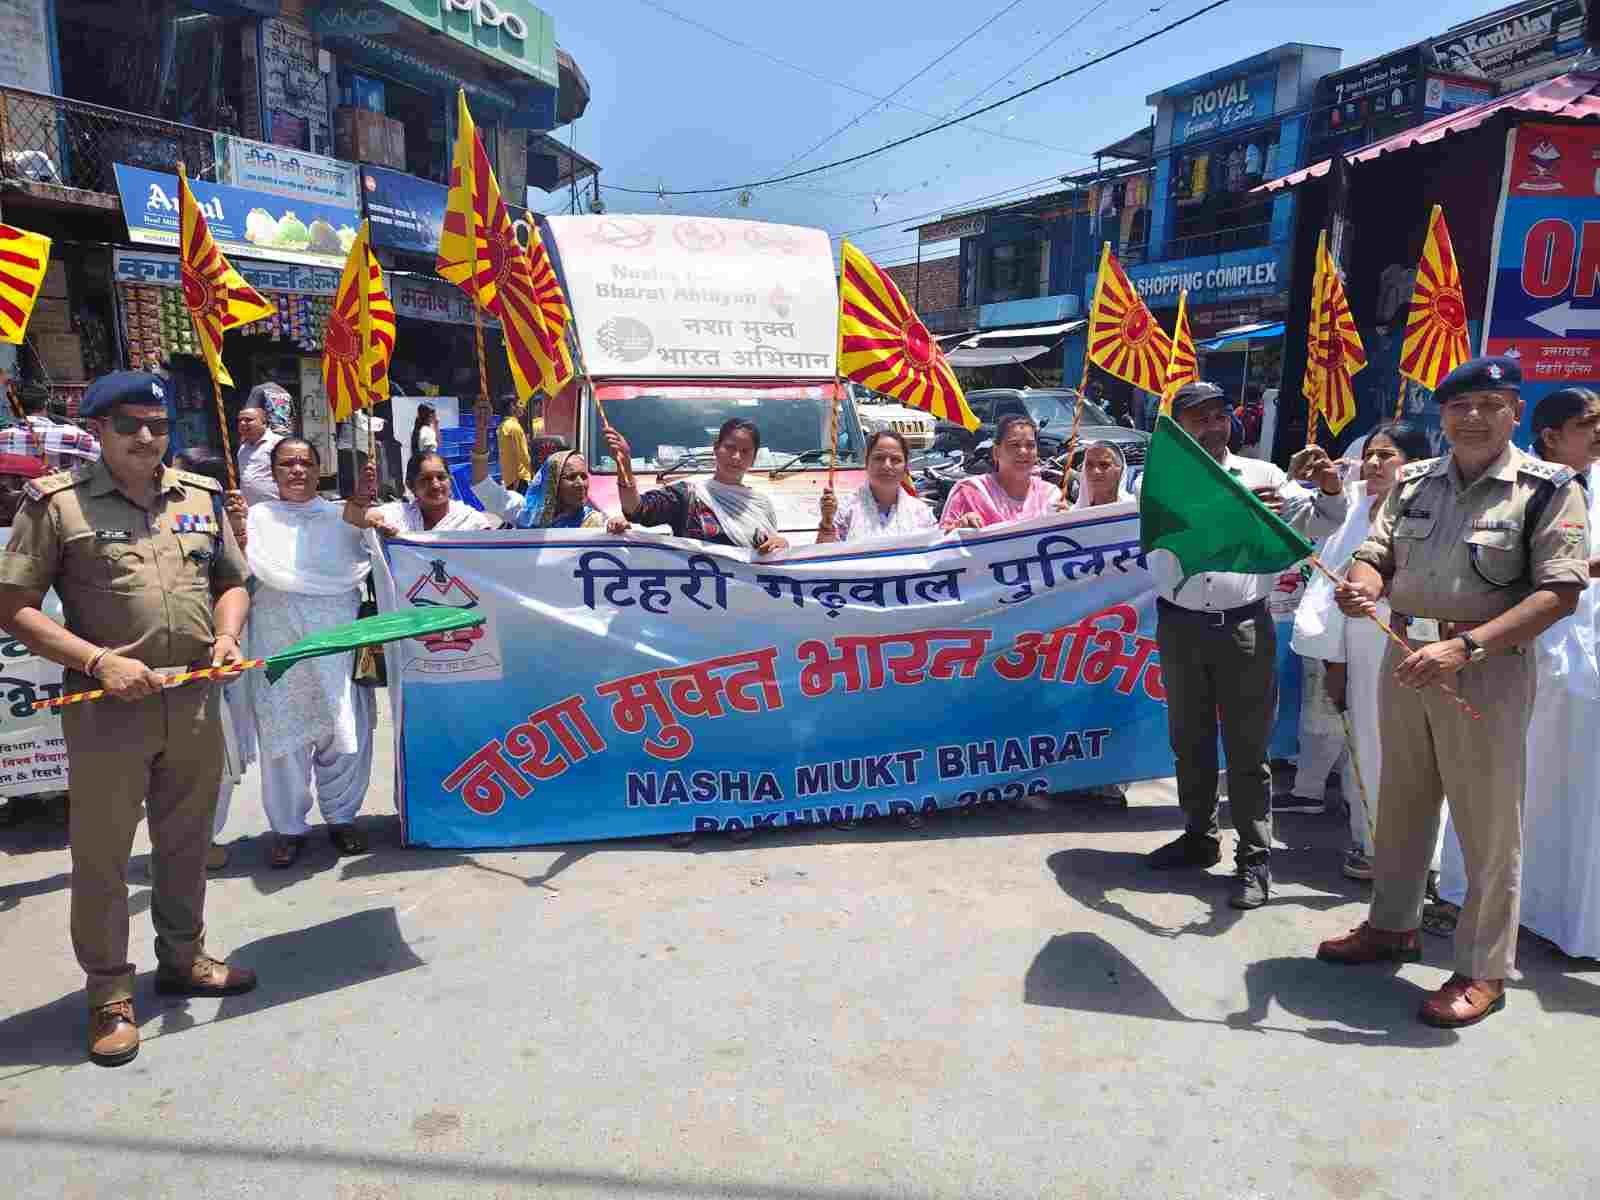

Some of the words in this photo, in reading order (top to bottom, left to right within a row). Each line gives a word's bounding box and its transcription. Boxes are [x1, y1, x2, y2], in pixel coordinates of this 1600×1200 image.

[1190, 80, 1249, 117] ROYAL
[146, 183, 225, 220] Aul
[1136, 269, 1203, 297] SHOPPING
[1206, 262, 1277, 289] COMPLEX
[681, 317, 733, 337] नशा
[741, 320, 796, 344] मुक्त
[656, 347, 721, 368] भारत
[733, 345, 830, 369] अभियान
[574, 550, 734, 614] टिहरी
[756, 567, 967, 618] गढ़वाल
[442, 693, 607, 816] नशा
[595, 646, 785, 761] मुक्त
[797, 628, 993, 698] भारत
[625, 770, 784, 808] NASHA
[794, 750, 924, 797] MUKT
[937, 727, 1112, 782] BHARAT
